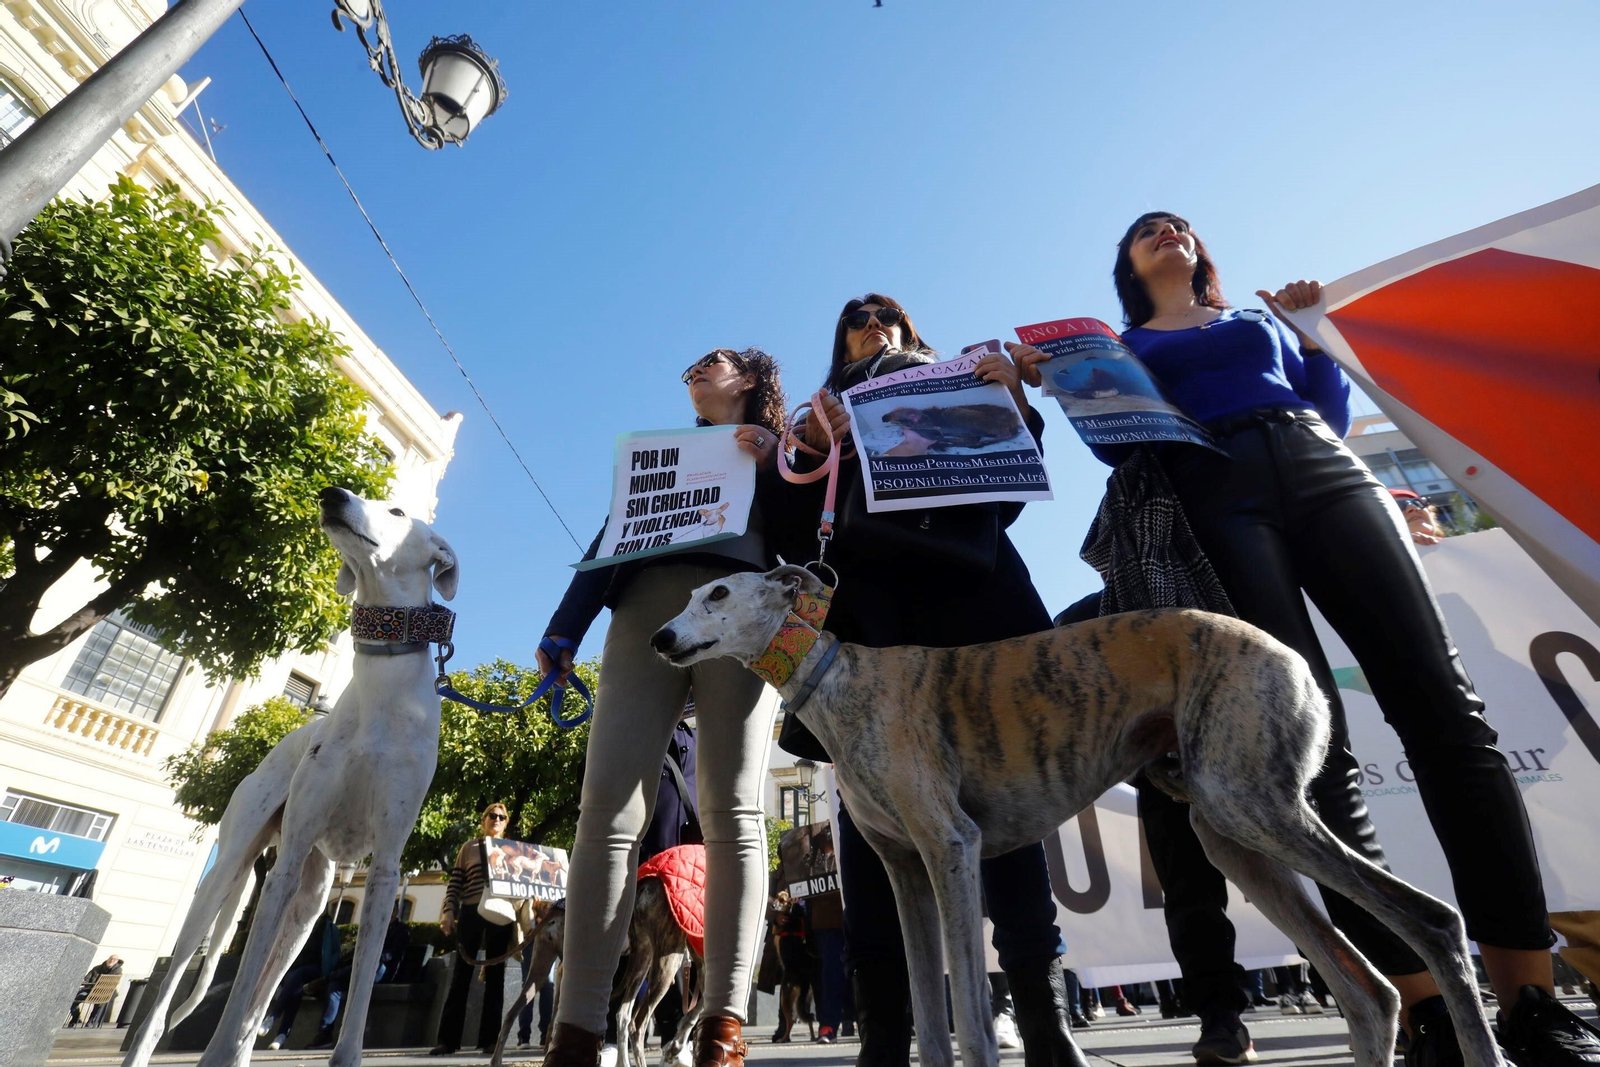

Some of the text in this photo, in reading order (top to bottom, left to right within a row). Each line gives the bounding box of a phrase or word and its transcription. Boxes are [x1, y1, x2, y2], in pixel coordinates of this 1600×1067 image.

[1066, 322, 1077, 332] A
[1082, 321, 1106, 332] LA
[1055, 347, 1075, 355] vida
[887, 376, 896, 384] A
[903, 370, 926, 380] LA
[941, 377, 969, 385] Perros
[912, 385, 957, 393] Protección
[631, 447, 680, 471] POR UN
[871, 454, 1041, 471] MismosPerrosMismaLey
[629, 470, 677, 495] MUNDO
[873, 472, 1047, 490] PSOENiUnSoloPerroAtrá
[626, 486, 721, 519] SIN CRUELDAD
[621, 509, 702, 539] Y VIOLENCIA
[1509, 746, 1550, 773] ur
[1360, 773, 1564, 798] SOCIACIÓN NIMALES
[511, 882, 527, 897] NO
[548, 887, 567, 901] CAZ
[810, 877, 827, 895] NO
[827, 875, 836, 891] A
